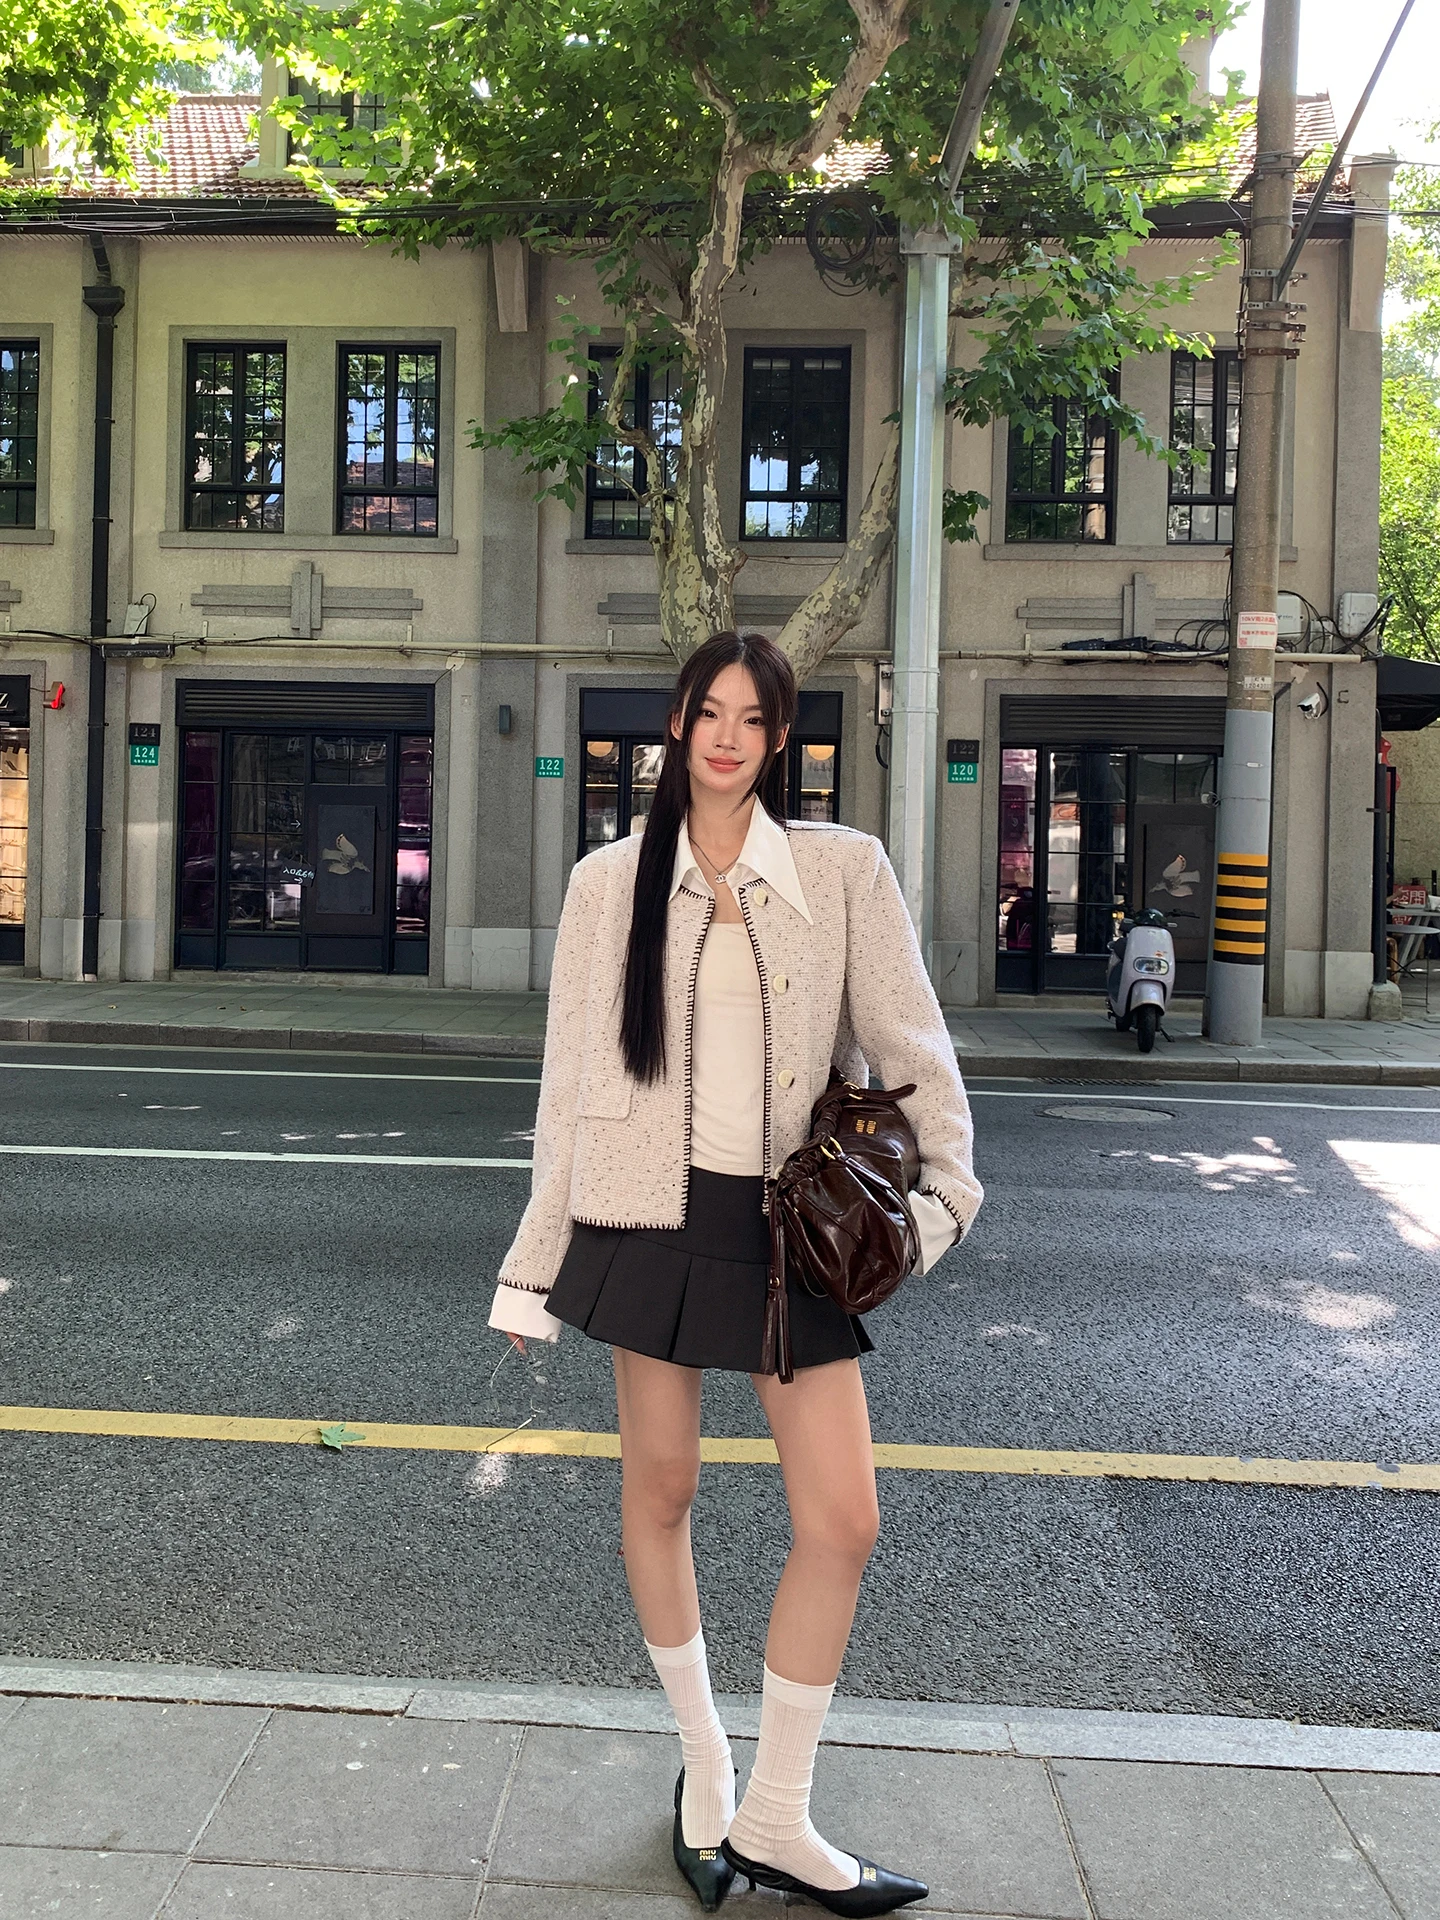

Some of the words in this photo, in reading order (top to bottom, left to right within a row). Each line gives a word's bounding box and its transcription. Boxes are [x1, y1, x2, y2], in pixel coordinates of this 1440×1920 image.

[134, 727, 156, 738] 124
[134, 747, 155, 758] 124
[952, 743, 975, 755] 122
[539, 759, 560, 770] 122
[952, 764, 974, 776] 120
